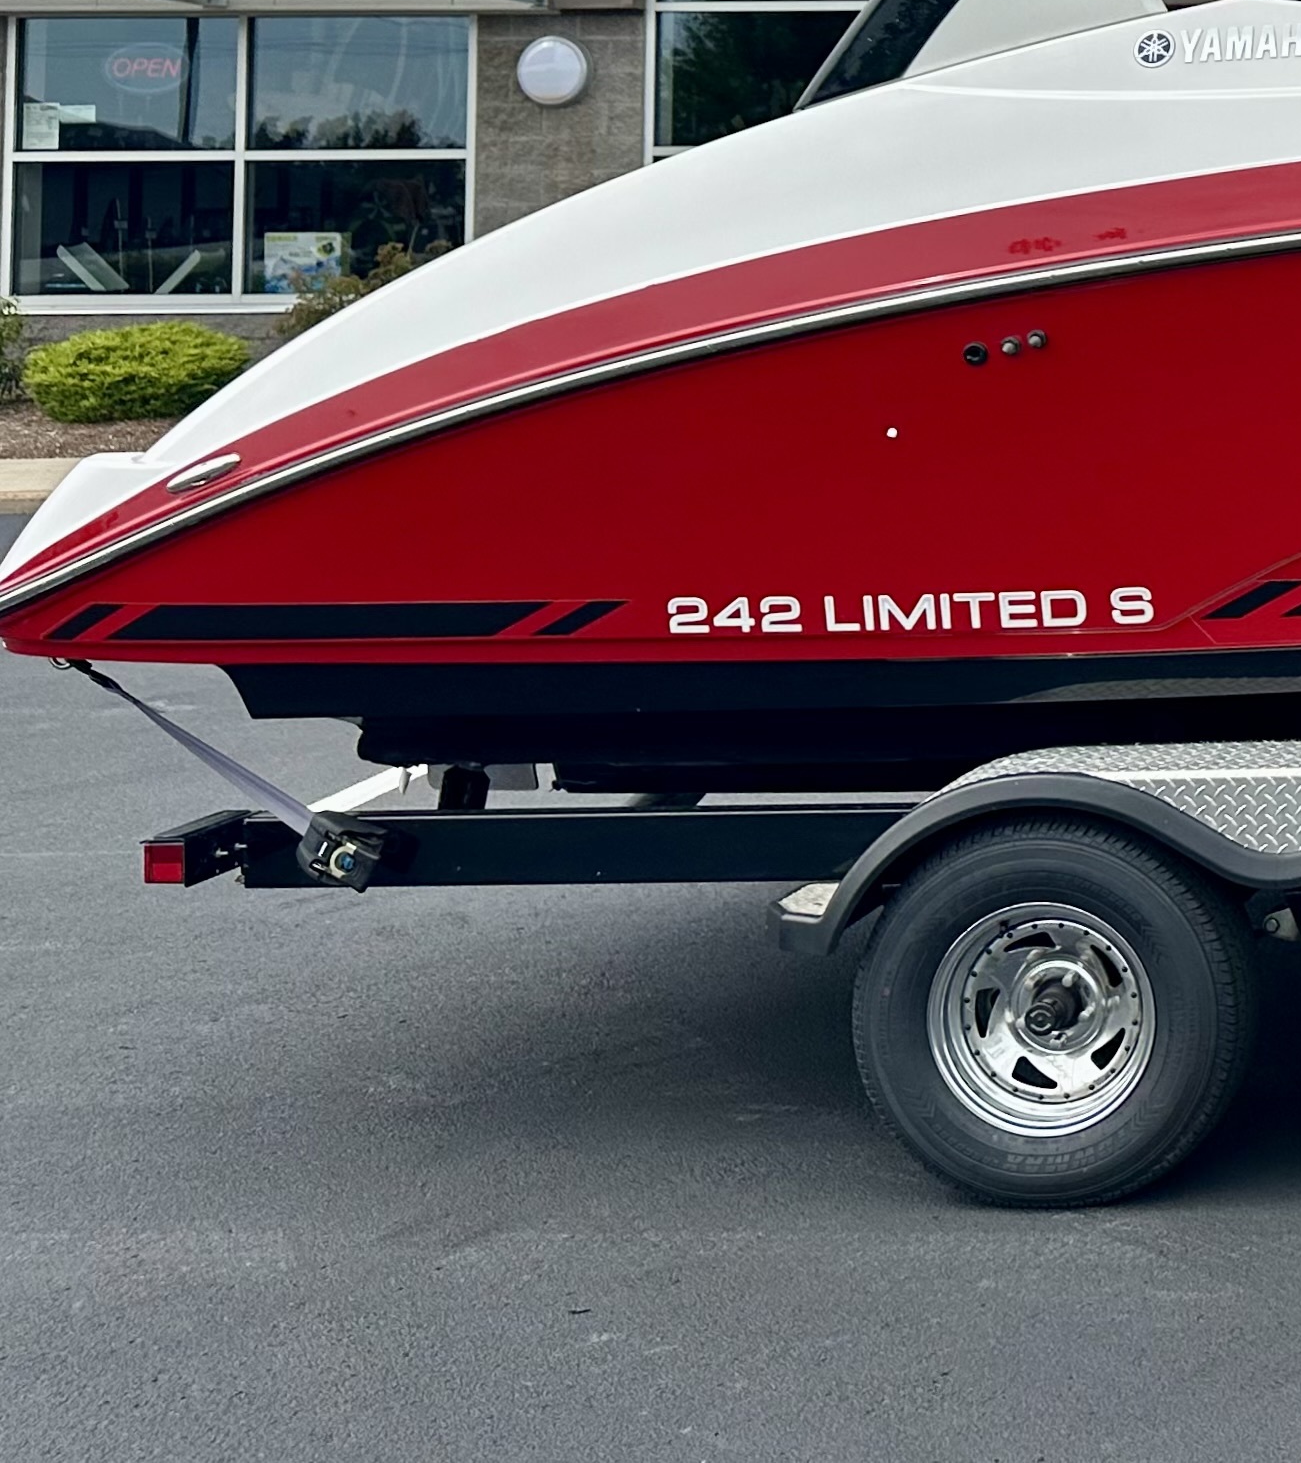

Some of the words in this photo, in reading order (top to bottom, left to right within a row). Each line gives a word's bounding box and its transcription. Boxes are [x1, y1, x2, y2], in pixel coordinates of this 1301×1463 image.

[112, 57, 183, 78] OPEN
[667, 595, 803, 634] 242
[823, 589, 1087, 632] LIMITED
[1109, 586, 1154, 625] S
